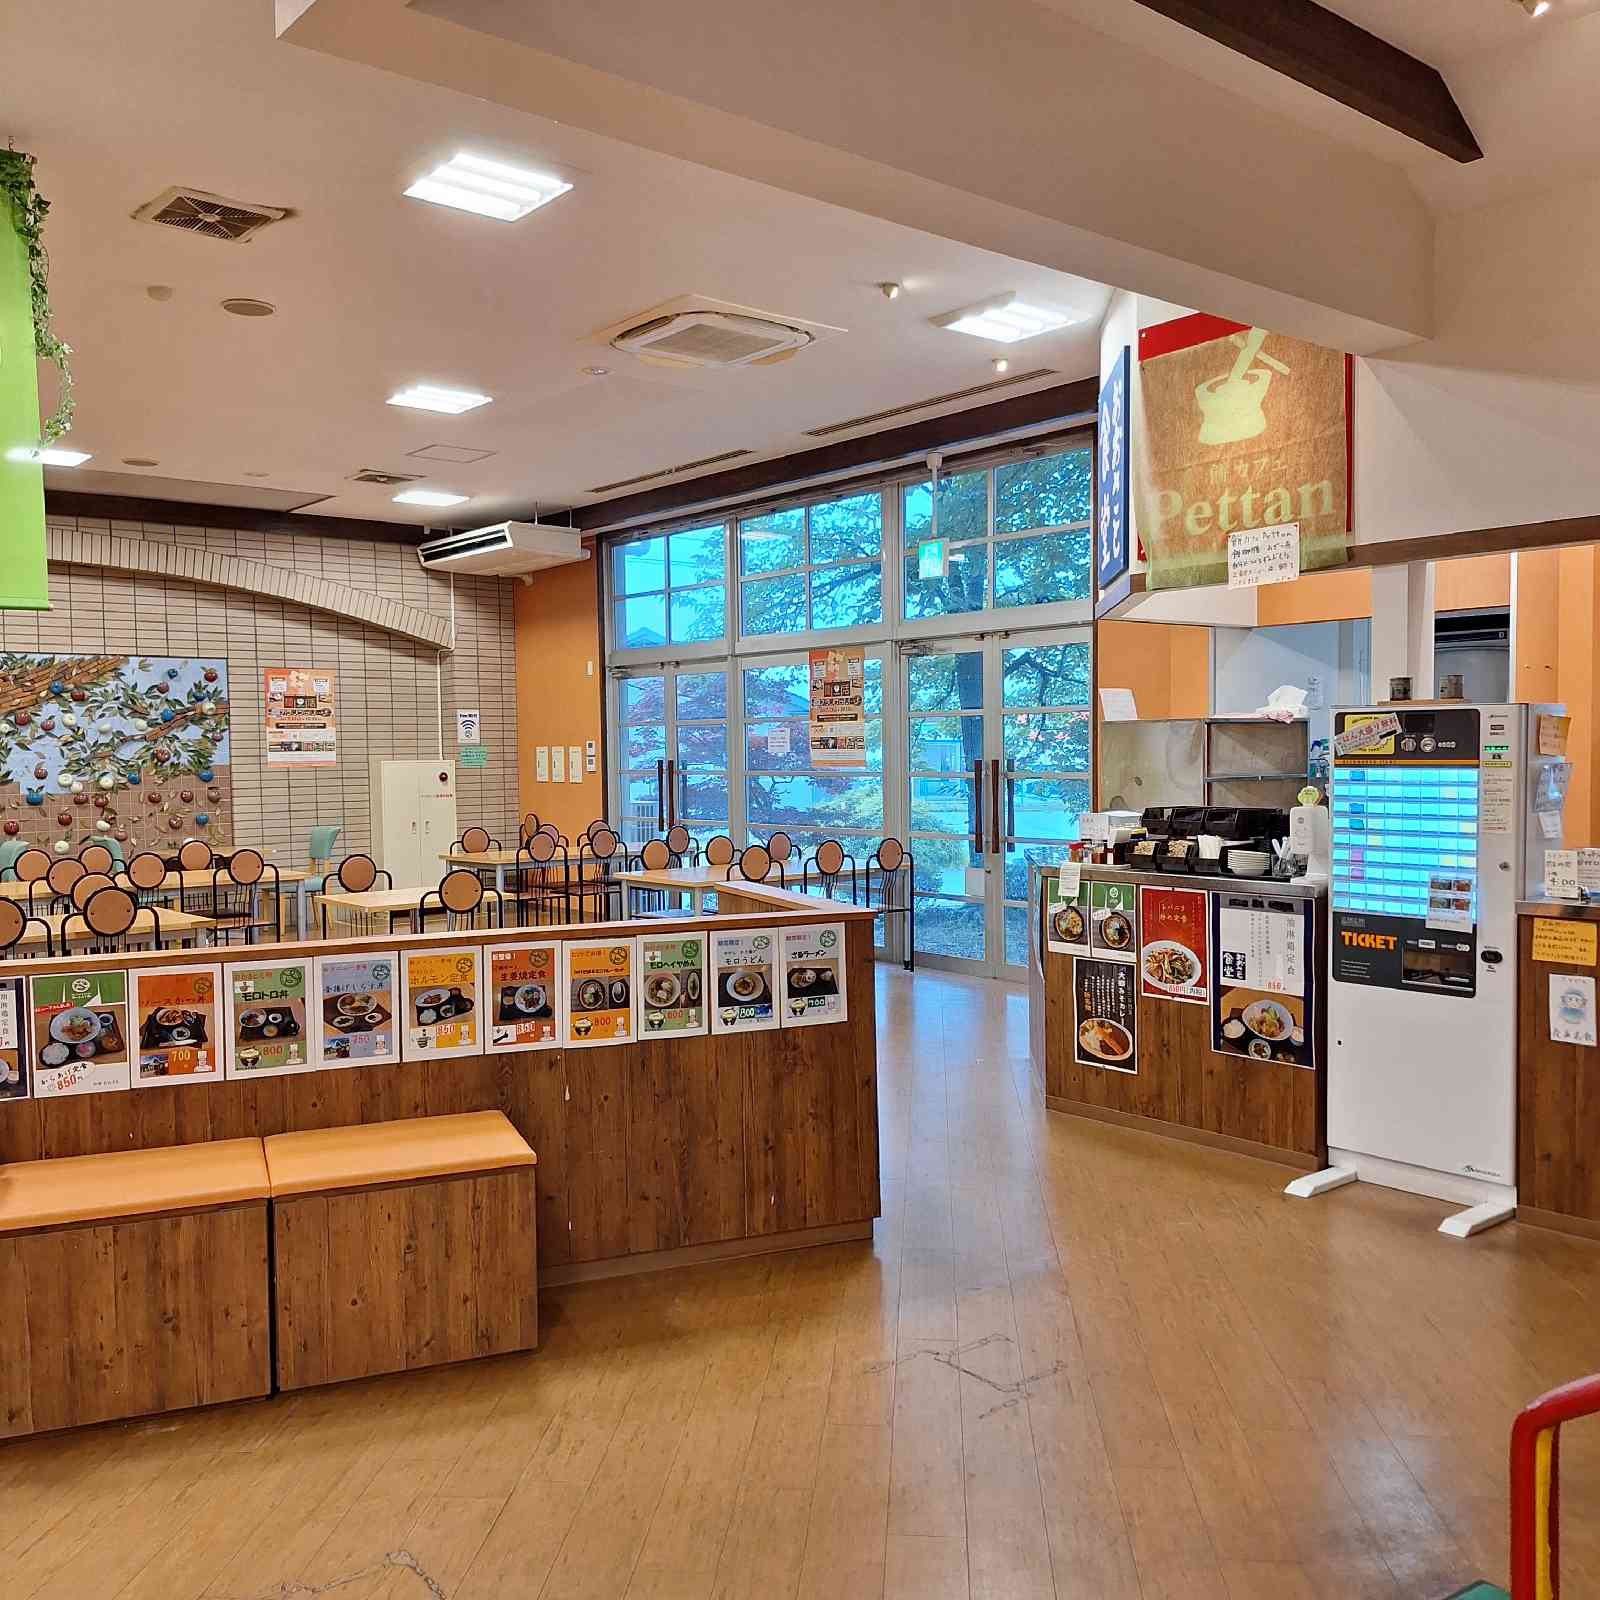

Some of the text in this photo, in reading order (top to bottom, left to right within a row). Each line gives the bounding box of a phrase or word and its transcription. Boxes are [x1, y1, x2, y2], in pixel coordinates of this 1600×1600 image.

[1156, 479, 1336, 536] Pettan
[1341, 932, 1397, 950] TICKET
[725, 955, 765, 965] モロうどん
[242, 990, 289, 1001] モロトロ丼
[171, 1049, 191, 1062] 700
